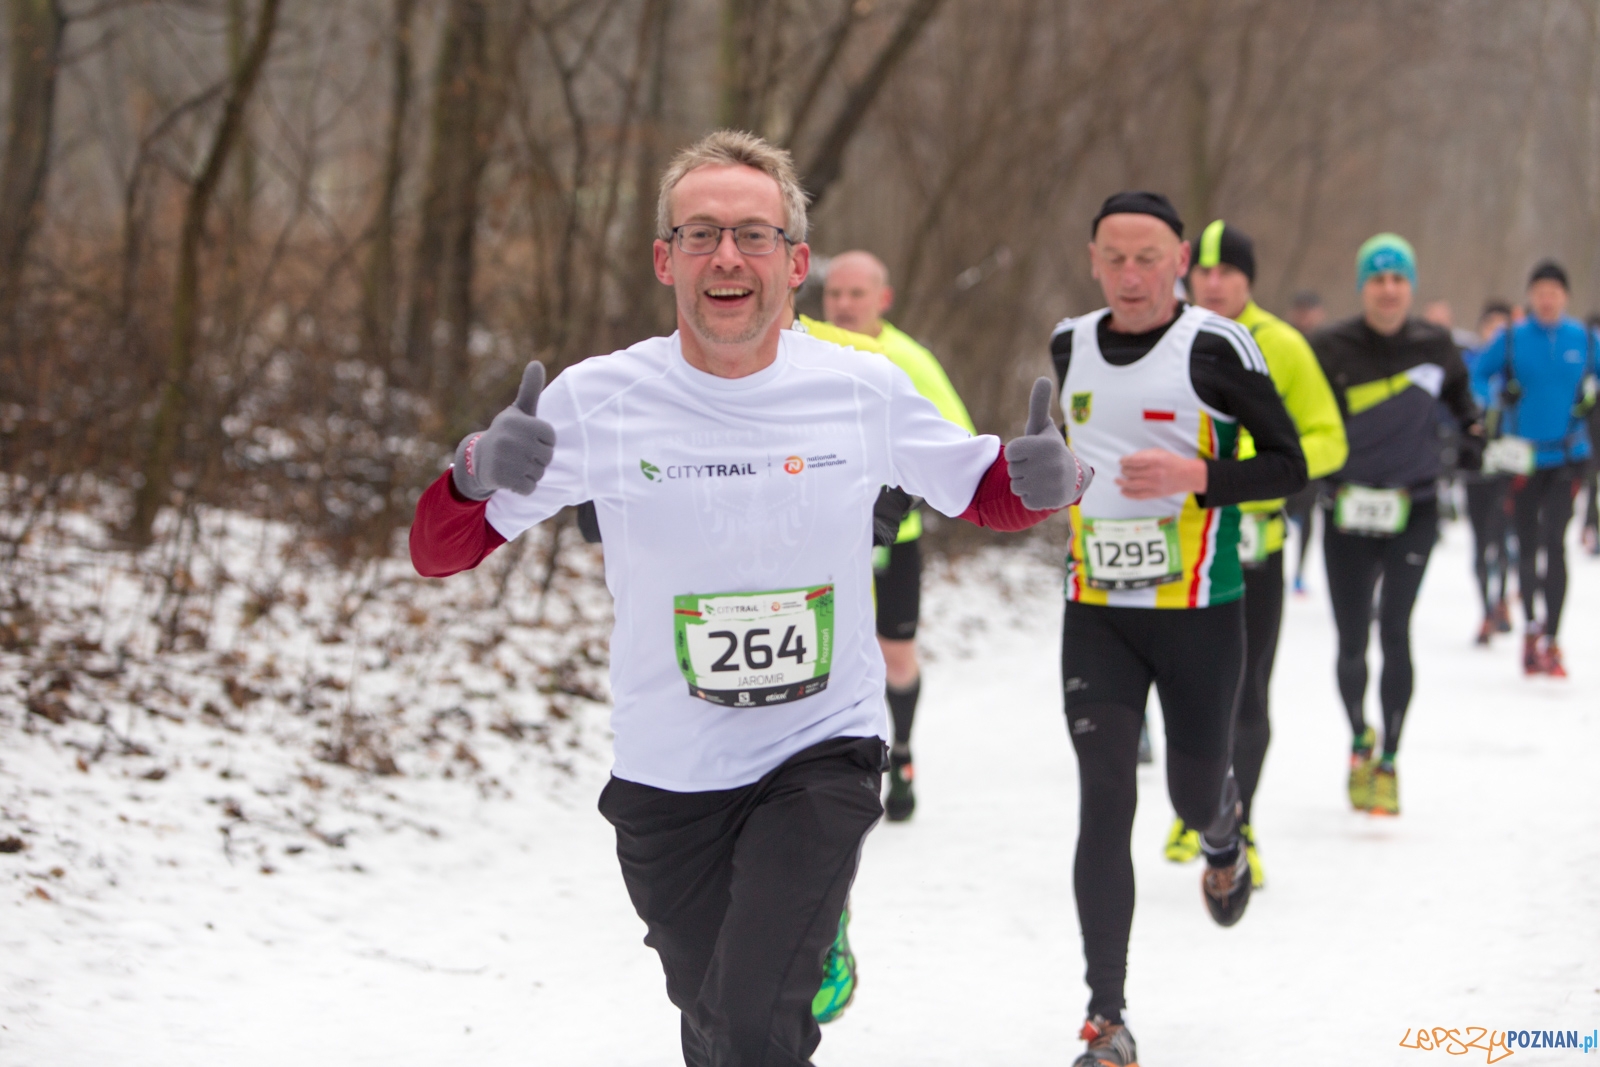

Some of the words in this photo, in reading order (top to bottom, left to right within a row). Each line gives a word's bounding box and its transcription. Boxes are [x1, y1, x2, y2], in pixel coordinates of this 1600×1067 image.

[806, 453, 837, 462] nationale
[807, 459, 847, 469] nederlanden
[1093, 540, 1165, 567] 1295
[708, 625, 807, 673] 264
[737, 673, 785, 687] JAROMIR
